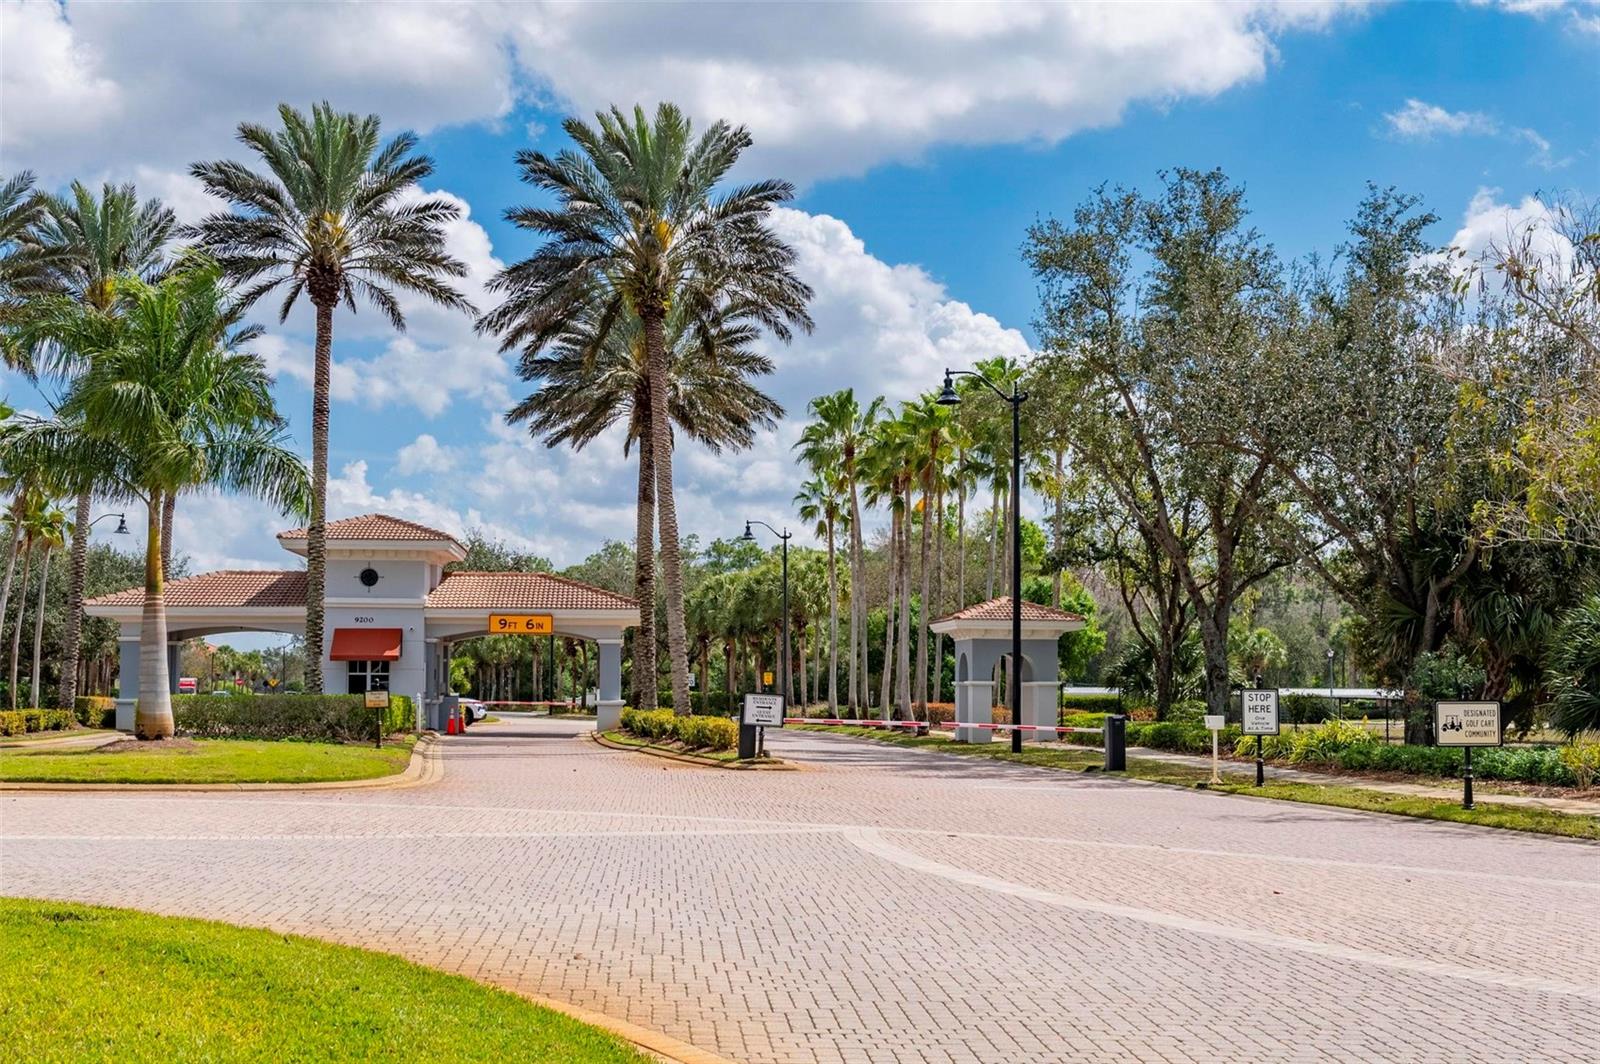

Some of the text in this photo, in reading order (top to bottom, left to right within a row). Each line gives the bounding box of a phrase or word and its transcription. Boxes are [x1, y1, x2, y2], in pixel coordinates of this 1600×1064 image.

[1248, 693, 1271, 702] STOP
[1248, 705, 1271, 713] HERE
[1463, 709, 1496, 717] DESIGNATED
[1481, 719, 1494, 727] CART
[1464, 730, 1496, 738] COMMUNITY
